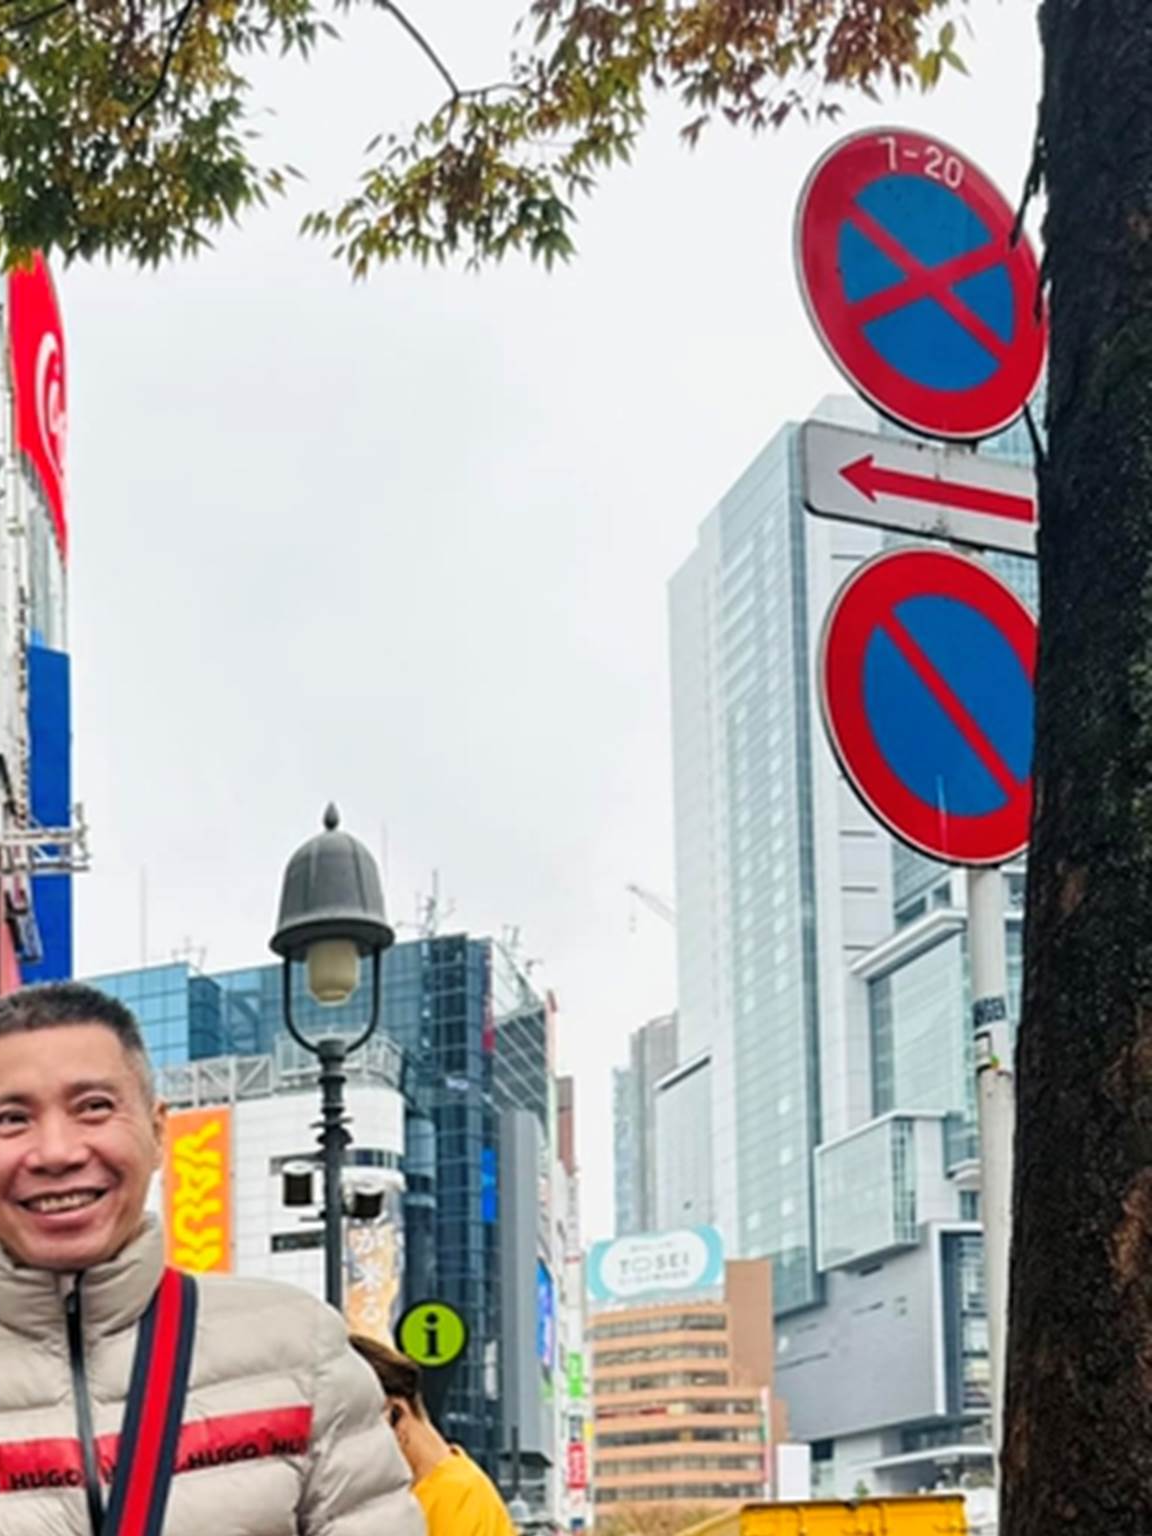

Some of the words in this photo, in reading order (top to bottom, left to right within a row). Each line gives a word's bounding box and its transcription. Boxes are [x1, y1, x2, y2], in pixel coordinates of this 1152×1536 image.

[877, 136, 965, 189] 7-20
[8, 1468, 82, 1491] HUGO
[186, 1442, 259, 1469] HUGO
